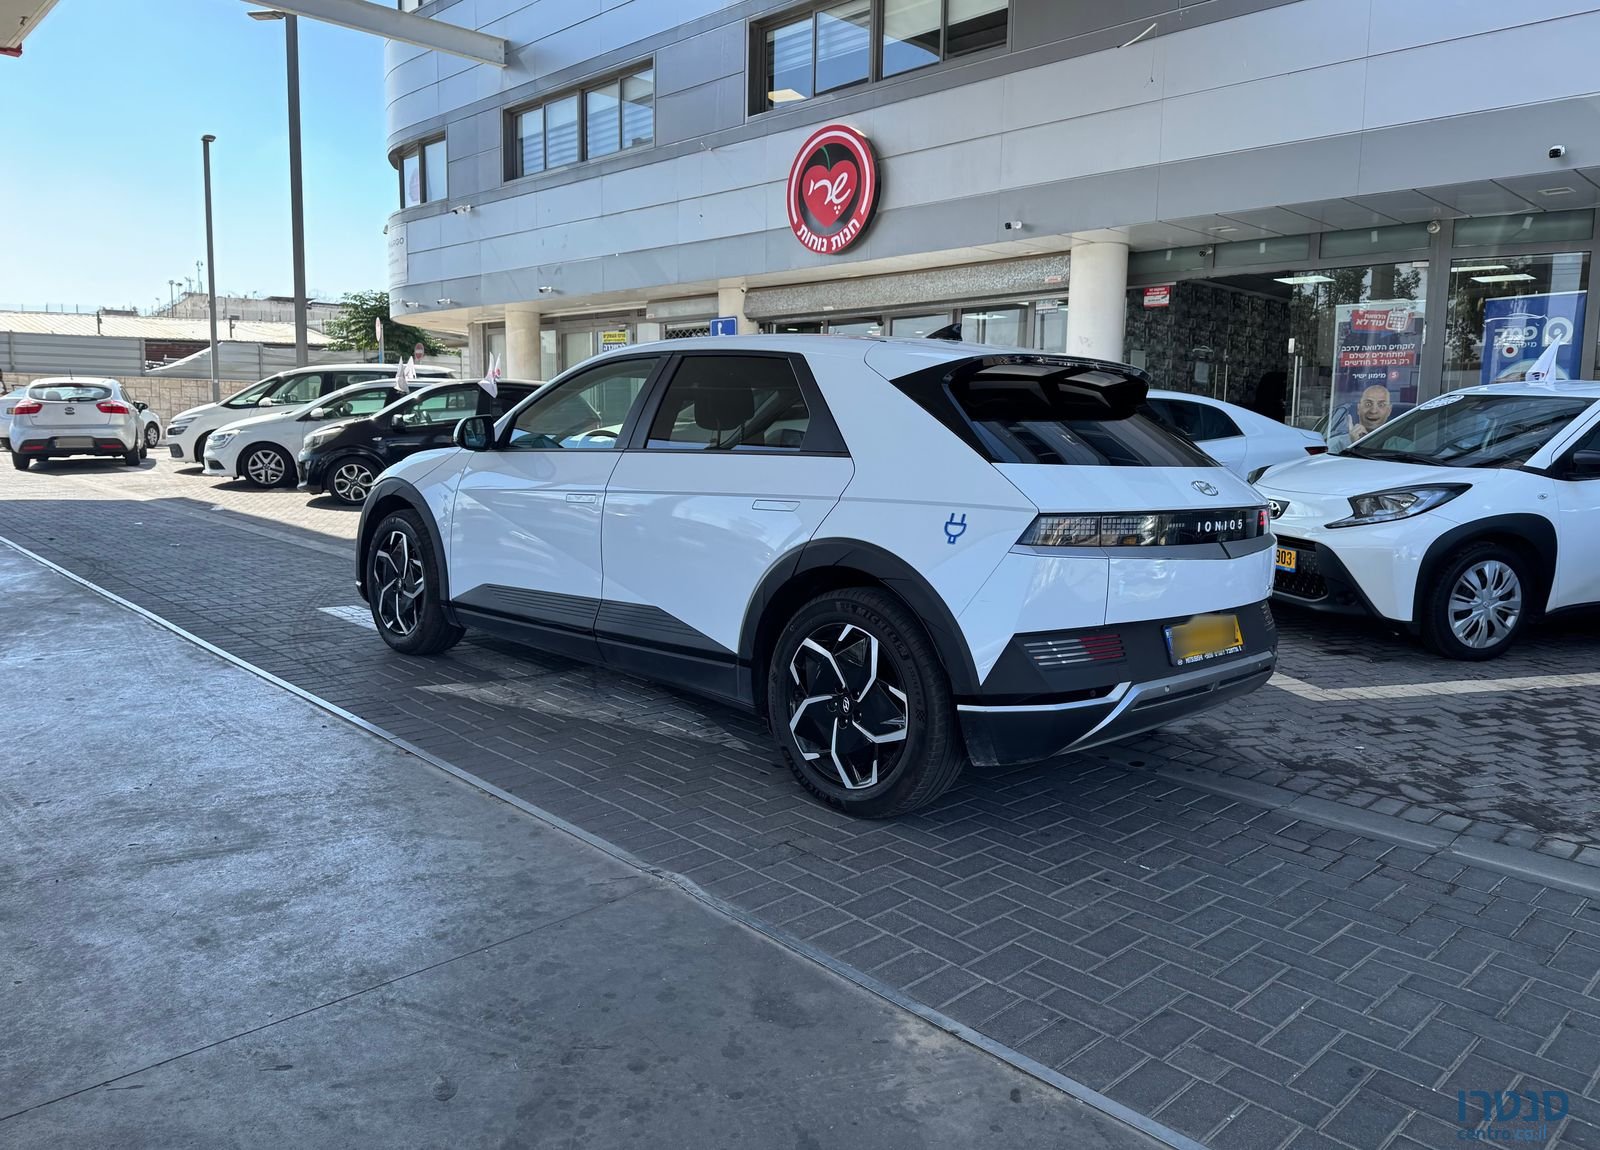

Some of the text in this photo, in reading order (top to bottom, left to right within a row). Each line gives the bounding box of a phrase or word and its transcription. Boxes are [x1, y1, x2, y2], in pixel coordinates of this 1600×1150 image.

[797, 218, 860, 252] חנות נוחות
[1389, 343, 1415, 351] לוקחים
